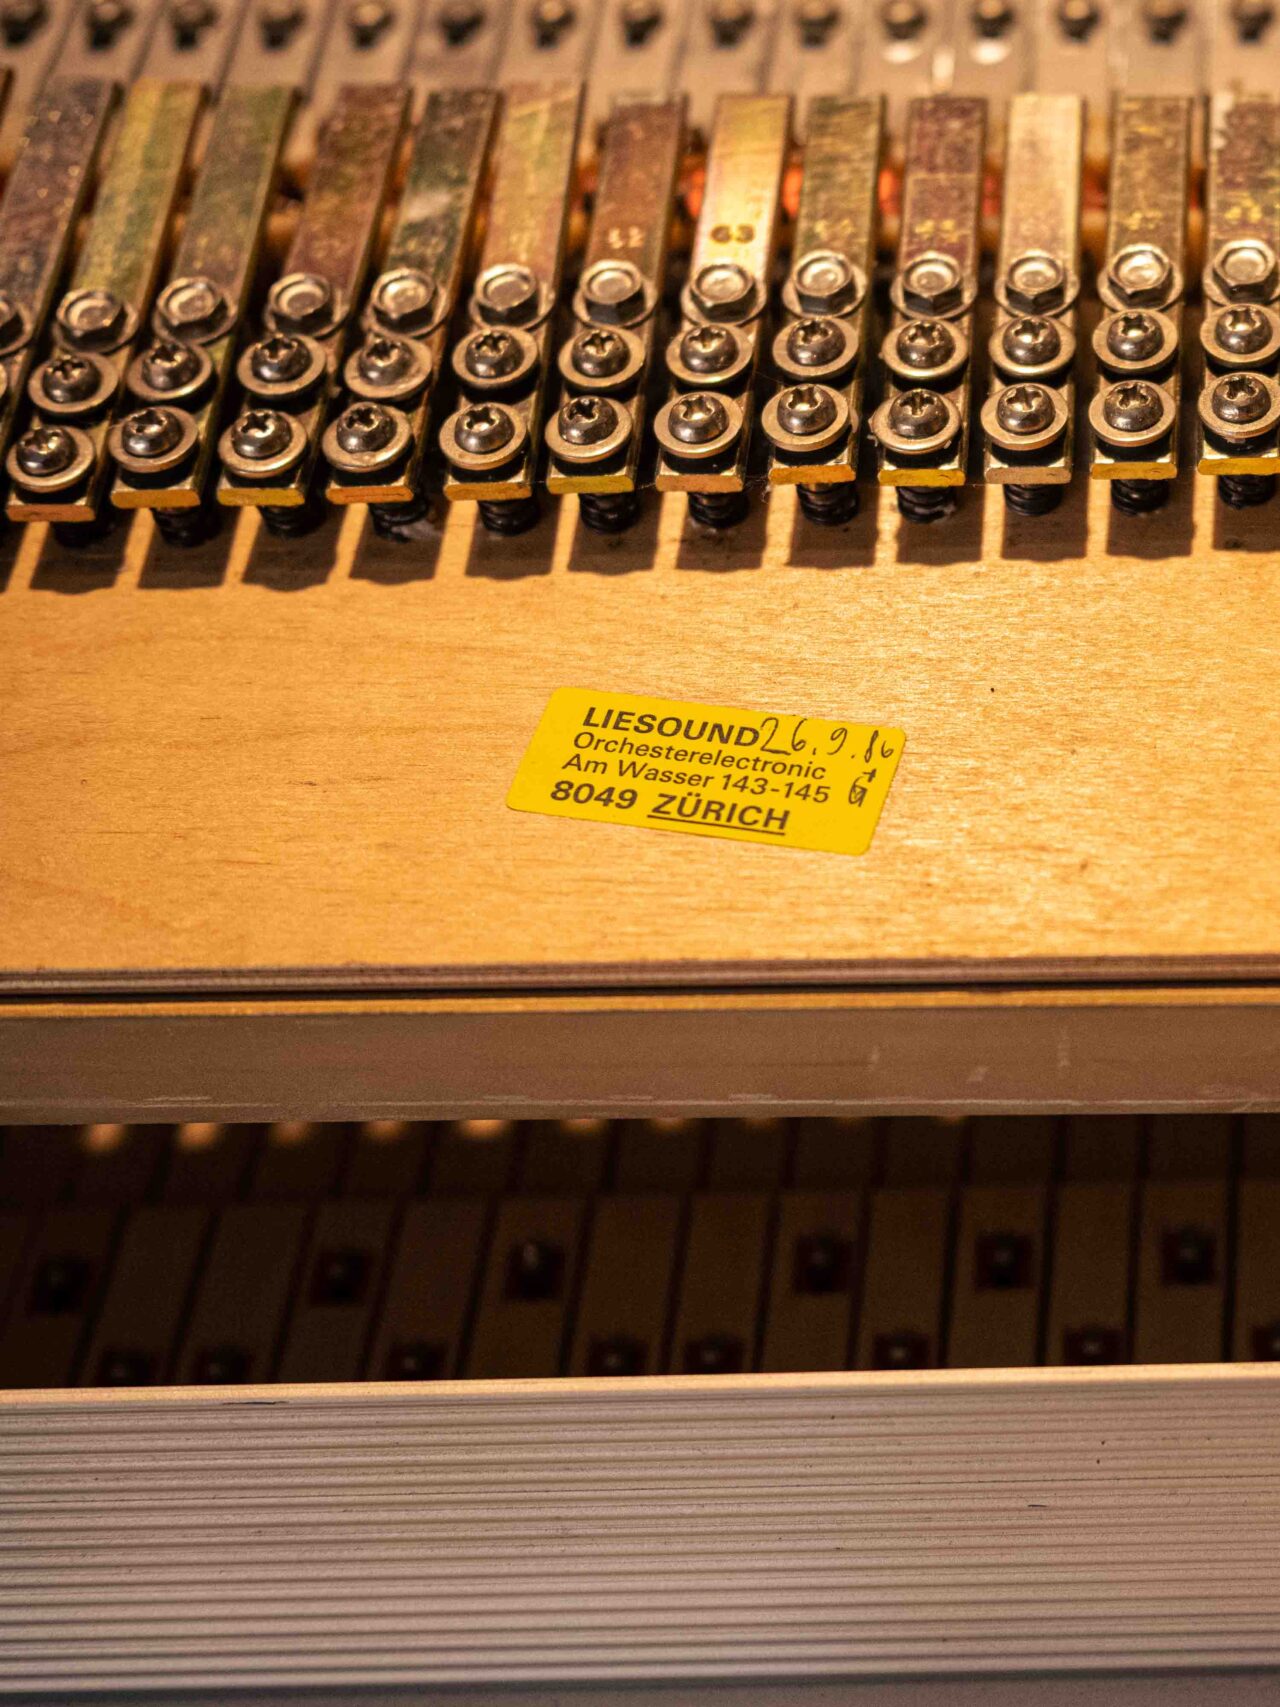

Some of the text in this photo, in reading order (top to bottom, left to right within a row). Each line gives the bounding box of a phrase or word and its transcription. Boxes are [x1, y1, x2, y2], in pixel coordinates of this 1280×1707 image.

[582, 707, 760, 747] LIESOUND
[561, 753, 608, 775] Am
[618, 759, 715, 788] Wasser
[722, 773, 831, 803] 143-145
[573, 731, 827, 780] Orchesterelectronic
[550, 780, 790, 830] 8049 ZÜRICH
